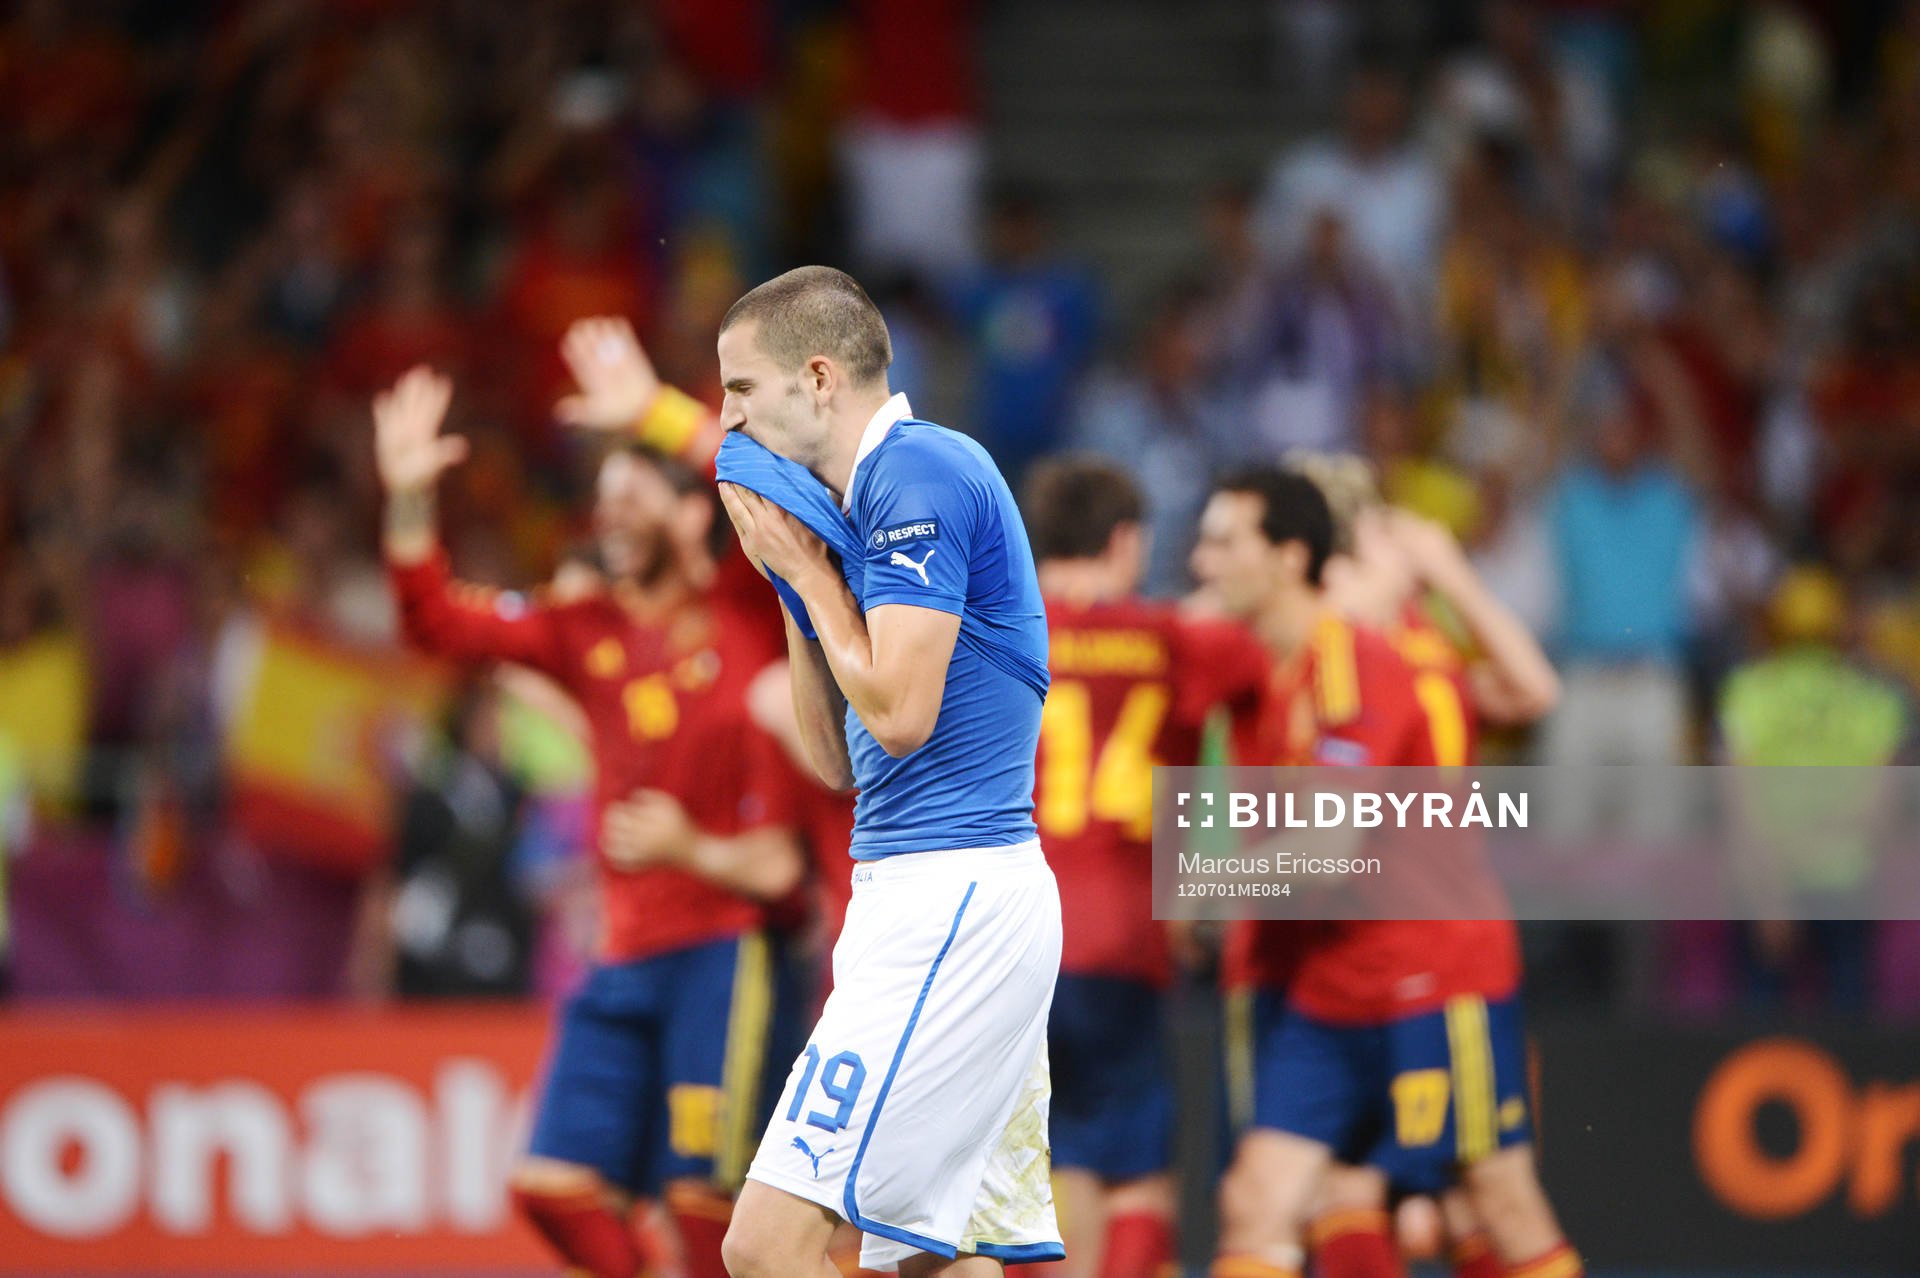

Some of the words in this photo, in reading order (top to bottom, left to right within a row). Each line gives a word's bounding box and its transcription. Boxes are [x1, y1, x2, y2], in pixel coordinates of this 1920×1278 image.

[887, 523, 936, 542] RESPECT
[1040, 680, 1170, 843] 14
[0, 1058, 524, 1238] onal
[786, 1043, 868, 1134] 19
